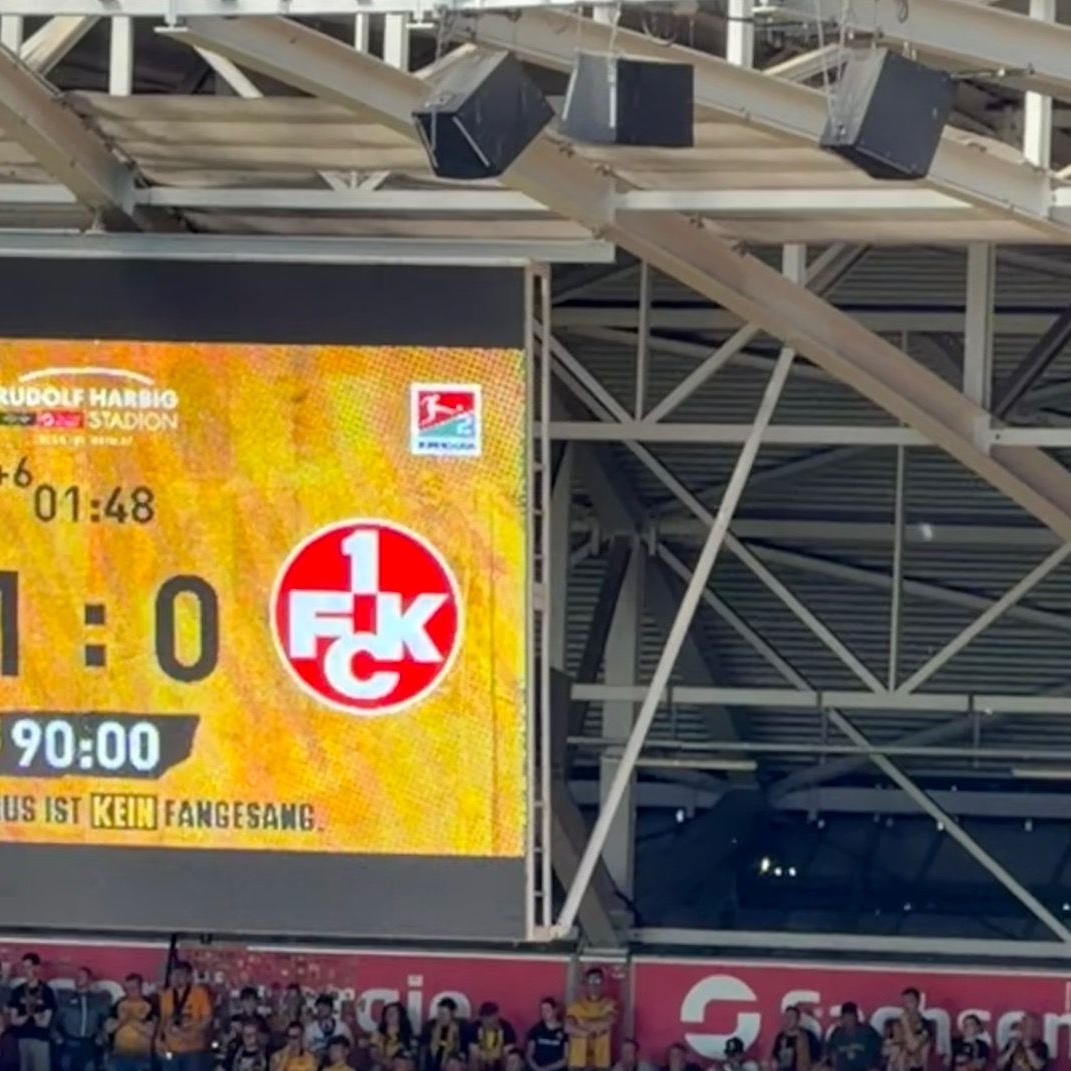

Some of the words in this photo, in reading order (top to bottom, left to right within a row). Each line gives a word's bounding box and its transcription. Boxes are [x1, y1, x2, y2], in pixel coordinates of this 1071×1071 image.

[89, 387, 179, 409] HARBIG
[87, 410, 178, 431] STADION
[34, 483, 155, 524] 01:48
[154, 573, 220, 683] 0
[11, 719, 161, 771] 90:00
[45, 796, 83, 824] IST
[92, 794, 157, 829] KEIN
